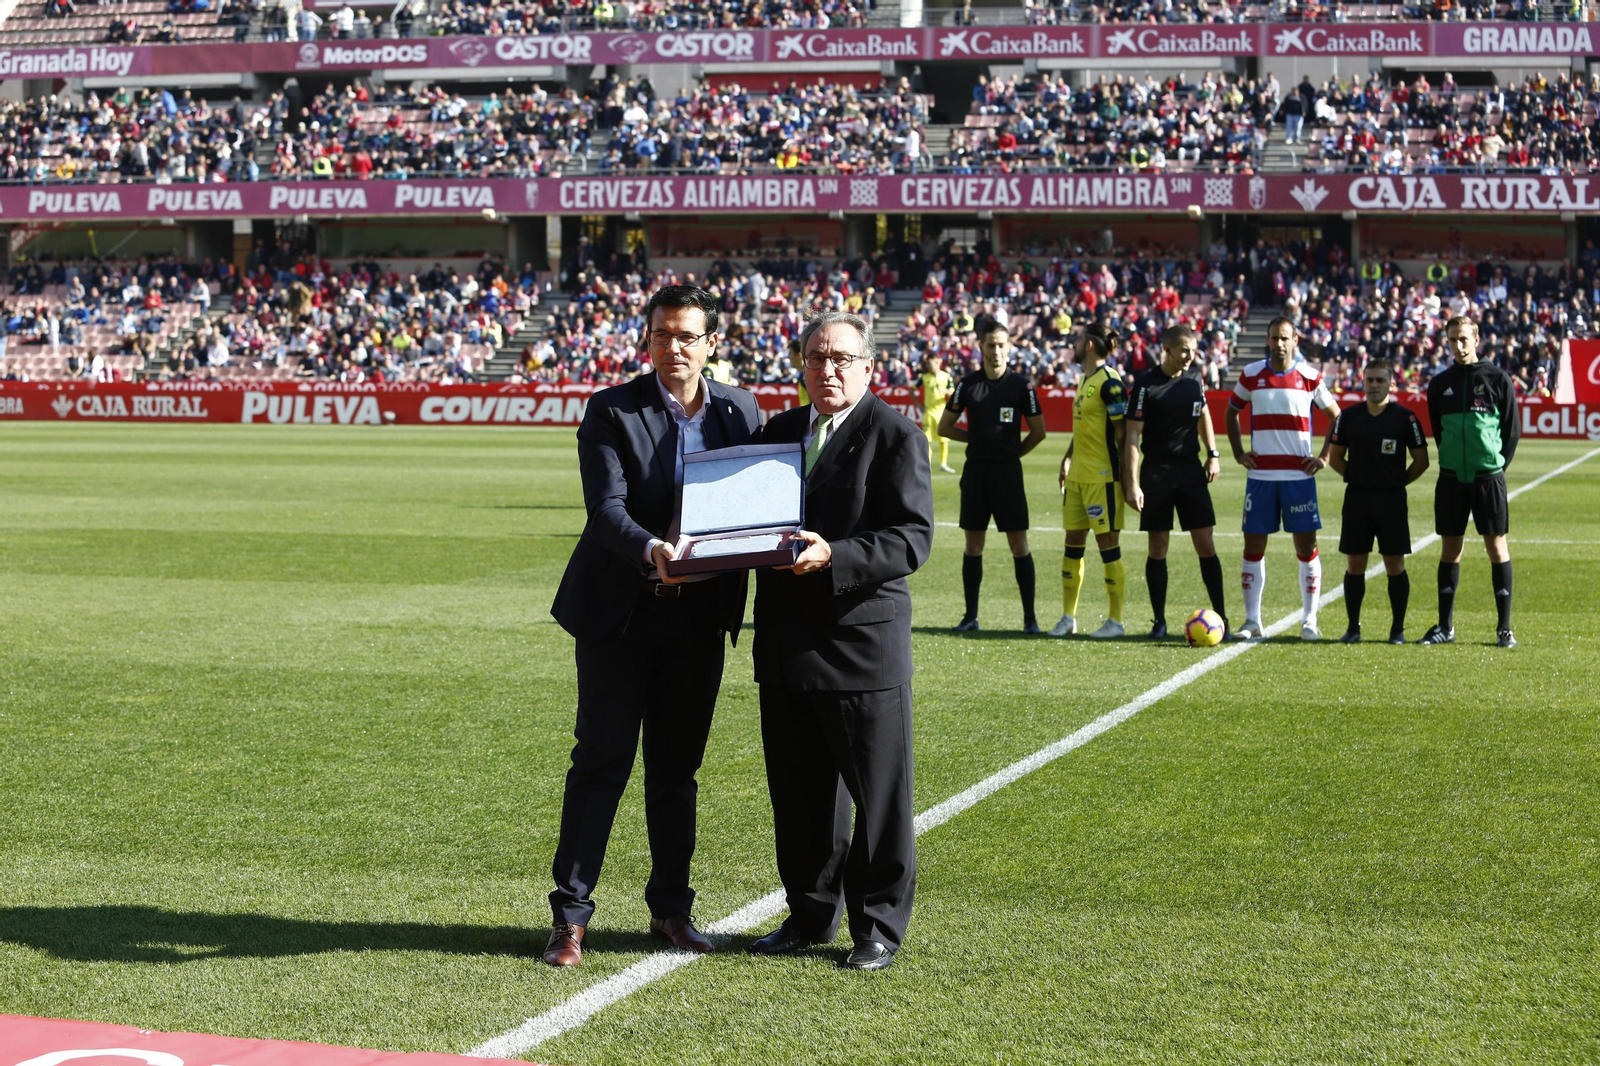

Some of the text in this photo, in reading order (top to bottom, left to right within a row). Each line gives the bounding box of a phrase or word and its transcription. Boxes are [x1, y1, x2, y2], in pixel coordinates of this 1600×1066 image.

[495, 35, 592, 60] CASTOR
[655, 32, 754, 57] CASTOR
[806, 34, 918, 57] CaixaBank
[970, 31, 1084, 54] CaixaBank
[1137, 29, 1253, 53] CaixaBank
[1305, 28, 1423, 52] CaixaBank
[1463, 26, 1593, 53] GRANADA
[0, 47, 134, 76] Granada Hoy
[323, 44, 427, 64] MotorDOS
[28, 190, 121, 213] PULEVA
[147, 187, 243, 211] PULEVA
[269, 186, 367, 209] PULEVA
[394, 184, 495, 208] PULEVA
[560, 179, 839, 208] CERVEZAS ALHAMBRA SIN
[901, 177, 1192, 206] CERVEZAS ALHAMBRA SIN
[1348, 176, 1600, 211] CAJA RURAL
[76, 395, 208, 417] CAJA RURAL
[241, 391, 382, 424] PULEVA
